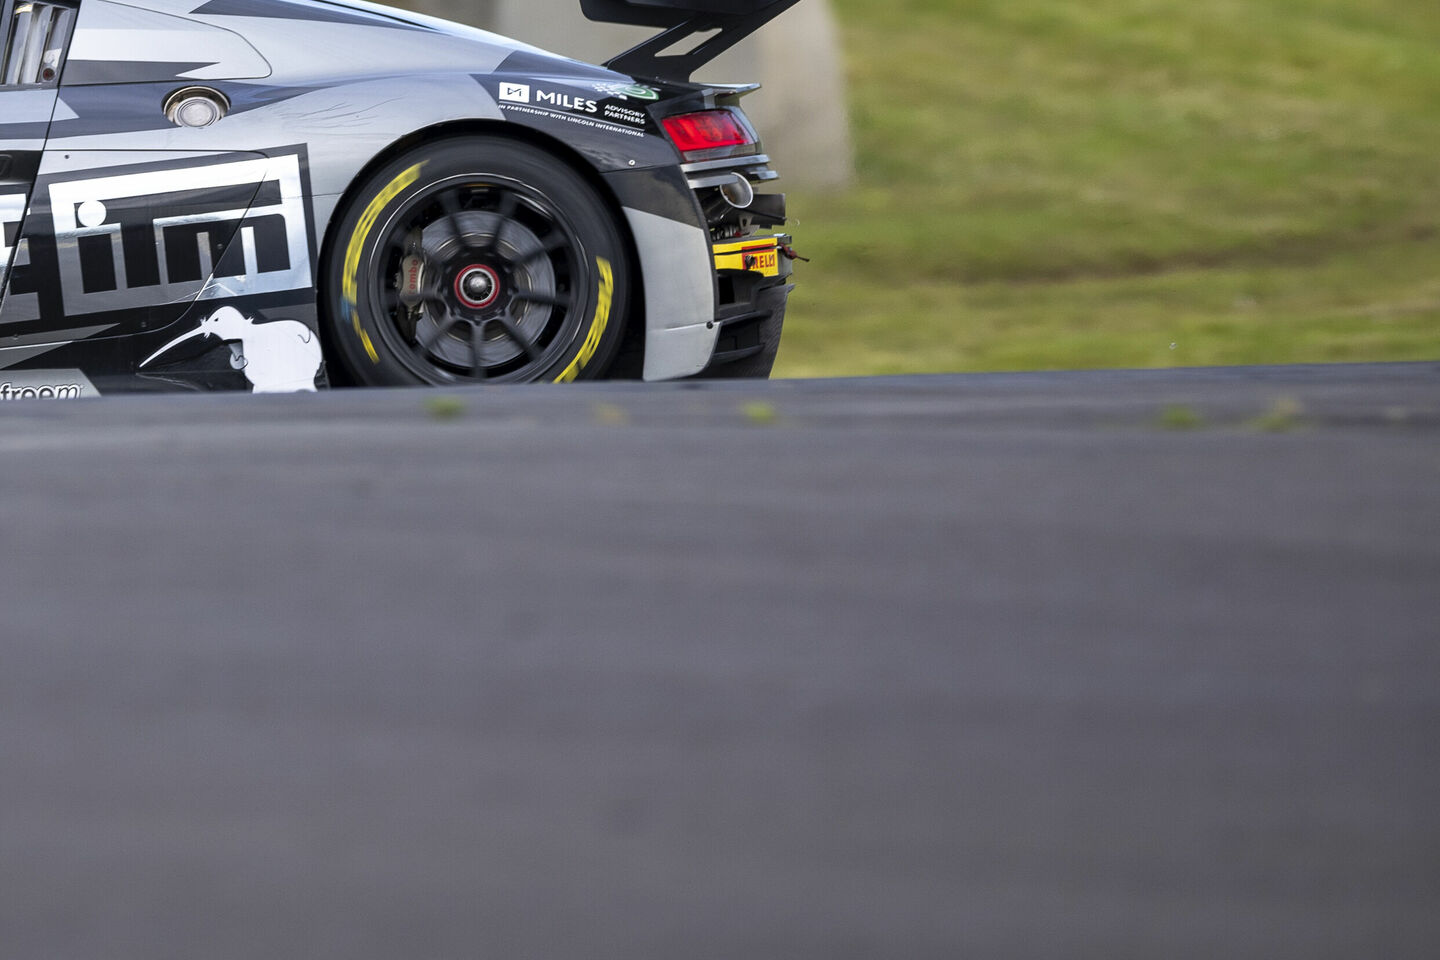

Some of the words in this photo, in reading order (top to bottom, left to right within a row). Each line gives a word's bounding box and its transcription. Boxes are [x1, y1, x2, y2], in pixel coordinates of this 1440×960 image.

[536, 89, 598, 113] MILES
[604, 104, 646, 118] ADVISORY
[604, 110, 646, 125] PARTNERS
[507, 105, 549, 117] PARTNERSHIP
[550, 112, 567, 121] WITH
[567, 116, 595, 128] LINCOLN
[595, 122, 645, 138] INTERNATIONAL
